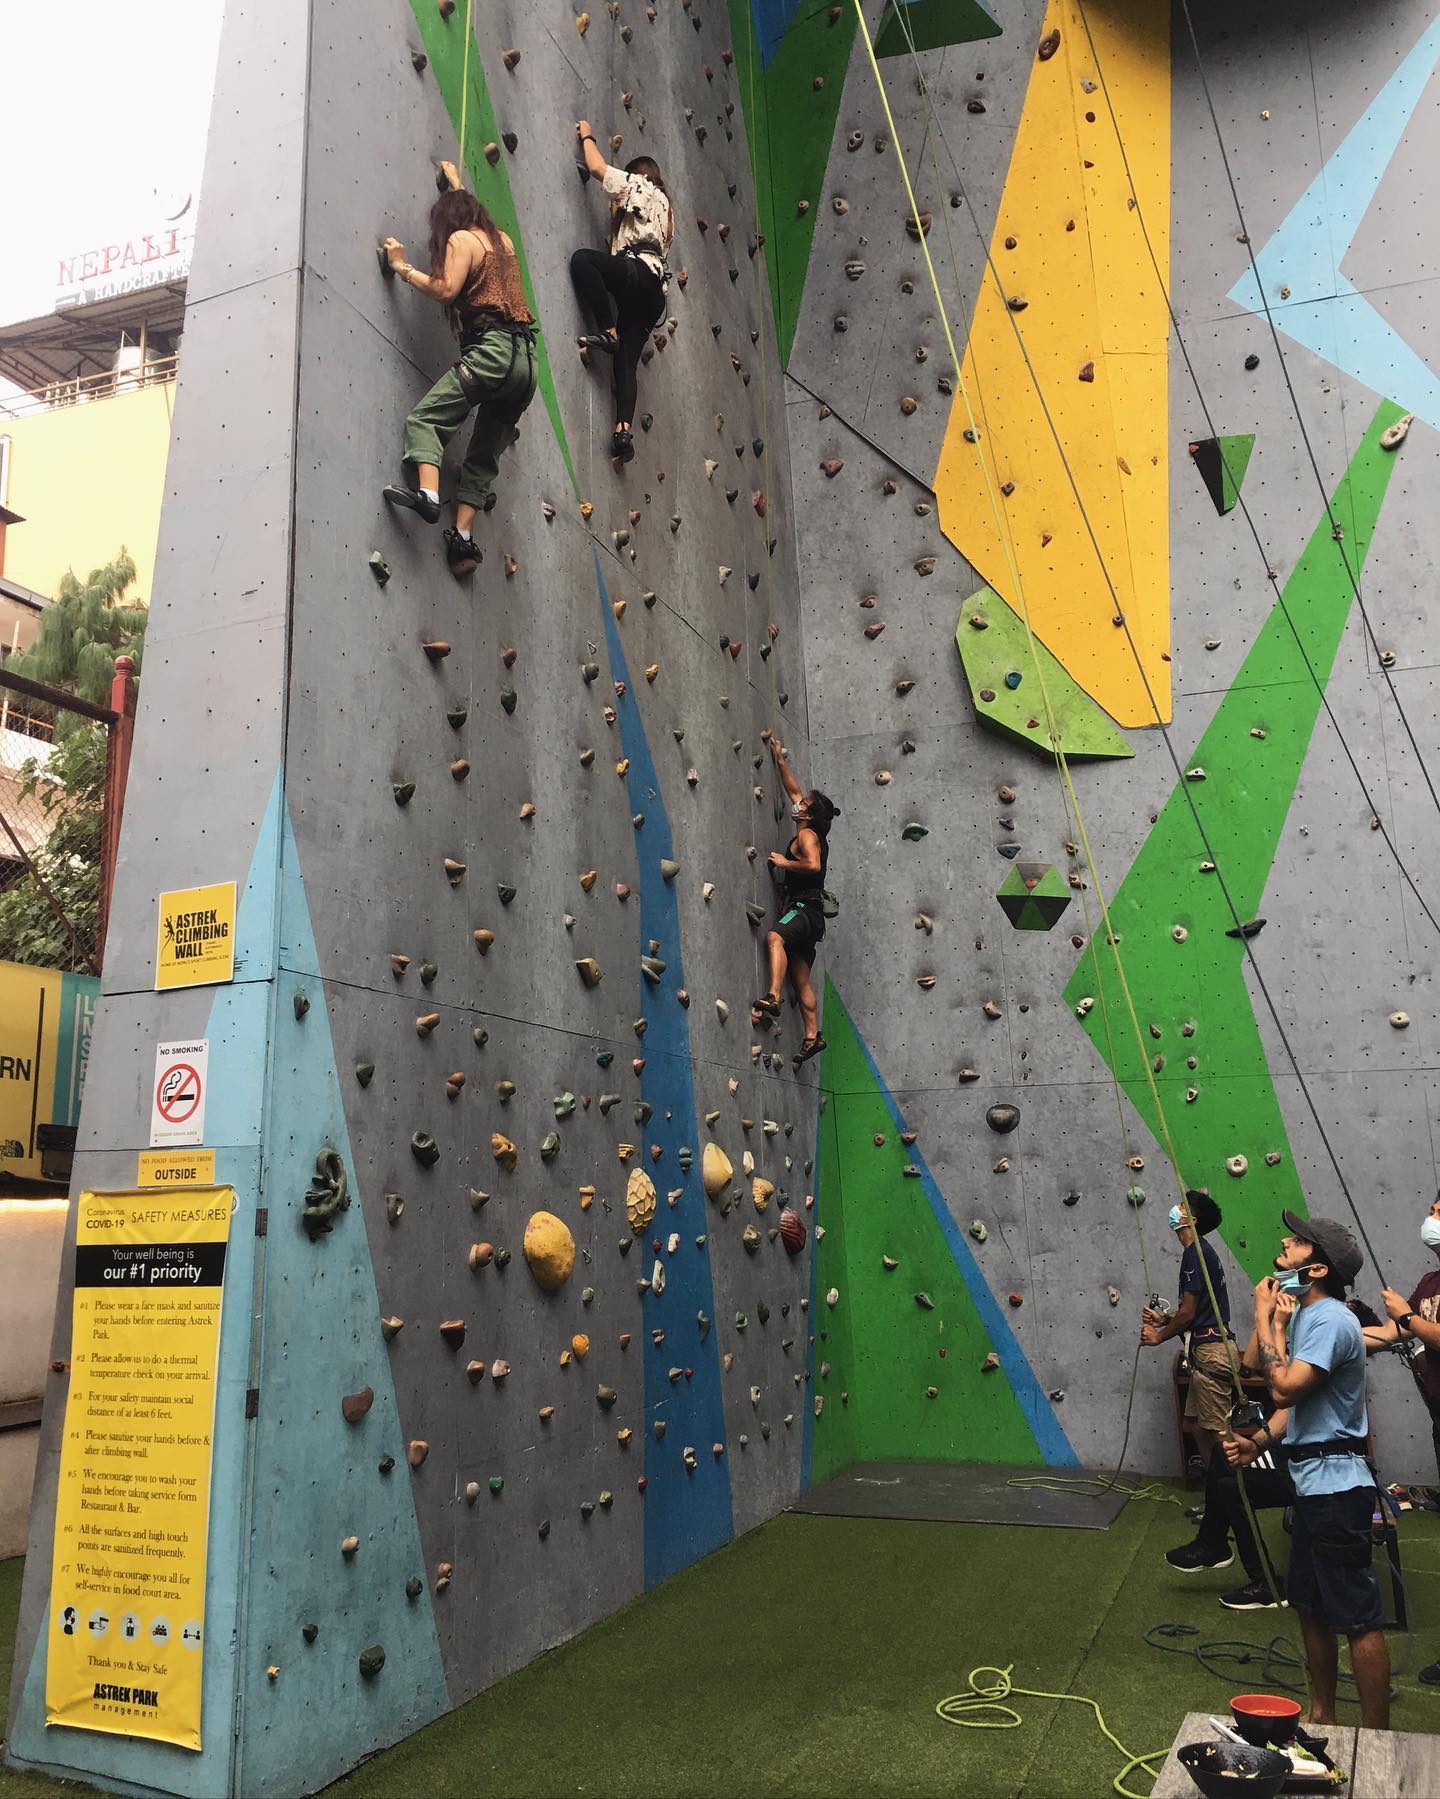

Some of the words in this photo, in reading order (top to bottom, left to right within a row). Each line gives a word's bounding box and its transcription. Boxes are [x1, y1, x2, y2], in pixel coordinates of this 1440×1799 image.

[56, 228, 180, 287] NEPALI
[176, 909, 217, 929] ASTREK
[176, 922, 228, 944] CLIMBING
[175, 942, 203, 959] WALL
[160, 1048, 170, 1056] NO
[171, 1045, 204, 1055] SMOKING
[155, 1168, 197, 1180] OUTSIDE
[87, 1208, 125, 1216] Coronavirus
[131, 1211, 168, 1224] SAFETY
[170, 1208, 227, 1222] MEASURES
[86, 1219, 125, 1229] COVID-19
[112, 1248, 132, 1261] Your
[135, 1248, 154, 1260] well
[156, 1247, 184, 1262] being
[186, 1247, 195, 1259] is
[103, 1267, 127, 1279] our
[129, 1263, 146, 1279] #1
[150, 1263, 202, 1283] priority
[95, 1300, 116, 1310] Please
[117, 1302, 133, 1310] wear
[141, 1300, 155, 1310] face
[156, 1300, 175, 1310] mask
[177, 1300, 192, 1310] and
[193, 1301, 220, 1311] sanitize
[93, 1317, 108, 1327] your
[110, 1315, 131, 1325] hands
[133, 1315, 154, 1325] before
[156, 1316, 186, 1327] entering
[188, 1315, 213, 1326] Astrek
[92, 1329, 110, 1339] Park.
[91, 1353, 112, 1363] Please
[113, 1353, 132, 1363] allow
[133, 1355, 142, 1363] us
[143, 1355, 150, 1364] to
[152, 1354, 161, 1364] do
[170, 1354, 198, 1365] thermal
[90, 1370, 131, 1380] temperature
[132, 1369, 153, 1379] check
[155, 1371, 164, 1379] on
[166, 1372, 183, 1381] your
[185, 1370, 210, 1380] arrival.
[88, 1391, 101, 1401] For
[102, 1393, 117, 1403] your
[120, 1392, 139, 1404] safety
[140, 1393, 172, 1404] maintain
[173, 1395, 194, 1404] social
[87, 1406, 114, 1417] distance
[116, 1407, 124, 1417] of
[125, 1408, 132, 1417] at
[133, 1408, 149, 1418] least
[150, 1409, 156, 1418] 6
[157, 1408, 173, 1419] feet.
[85, 1429, 107, 1440] Please
[109, 1432, 134, 1442] sanitize
[136, 1434, 152, 1444] your
[154, 1433, 175, 1444] hands
[177, 1435, 202, 1445] before
[203, 1436, 211, 1446] &
[84, 1445, 100, 1455] after
[102, 1446, 132, 1458] climbing
[133, 1448, 149, 1458] wall.
[83, 1468, 97, 1479] We
[98, 1472, 133, 1484] encourage
[134, 1474, 148, 1485] you
[149, 1474, 157, 1483] to
[158, 1475, 177, 1485] wash
[179, 1476, 197, 1486] your
[81, 1484, 102, 1495] hands
[104, 1486, 127, 1497] before
[128, 1488, 149, 1499] taking
[151, 1490, 176, 1500] service
[177, 1491, 197, 1501] form
[81, 1499, 117, 1512] Restaurant
[119, 1502, 125, 1512] &
[127, 1502, 142, 1513] Bar.
[80, 1523, 90, 1534] All
[91, 1524, 102, 1535] the
[104, 1527, 131, 1538] surfaces
[132, 1529, 147, 1539] and
[148, 1529, 165, 1541] high
[167, 1531, 188, 1542] touch
[78, 1540, 99, 1551] points
[101, 1544, 112, 1552] are
[113, 1543, 144, 1555] sanitized
[145, 1545, 186, 1559] frequently.
[77, 1563, 90, 1574] We
[91, 1566, 112, 1578] highly
[113, 1570, 151, 1582] encourage
[152, 1573, 167, 1583] you
[168, 1573, 178, 1583] all
[179, 1573, 191, 1585] for
[75, 1580, 112, 1593] self-service
[113, 1584, 121, 1594] in
[122, 1585, 141, 1596] food
[142, 1588, 161, 1598] court
[163, 1591, 181, 1600] area.
[88, 1655, 112, 1668] Thank
[113, 1661, 127, 1670] you
[128, 1660, 134, 1671] &
[136, 1661, 151, 1673] Stay
[153, 1663, 168, 1675] Safe
[93, 1683, 131, 1703] ASTREK
[132, 1688, 158, 1707] PARK
[93, 1703, 158, 1719] management
